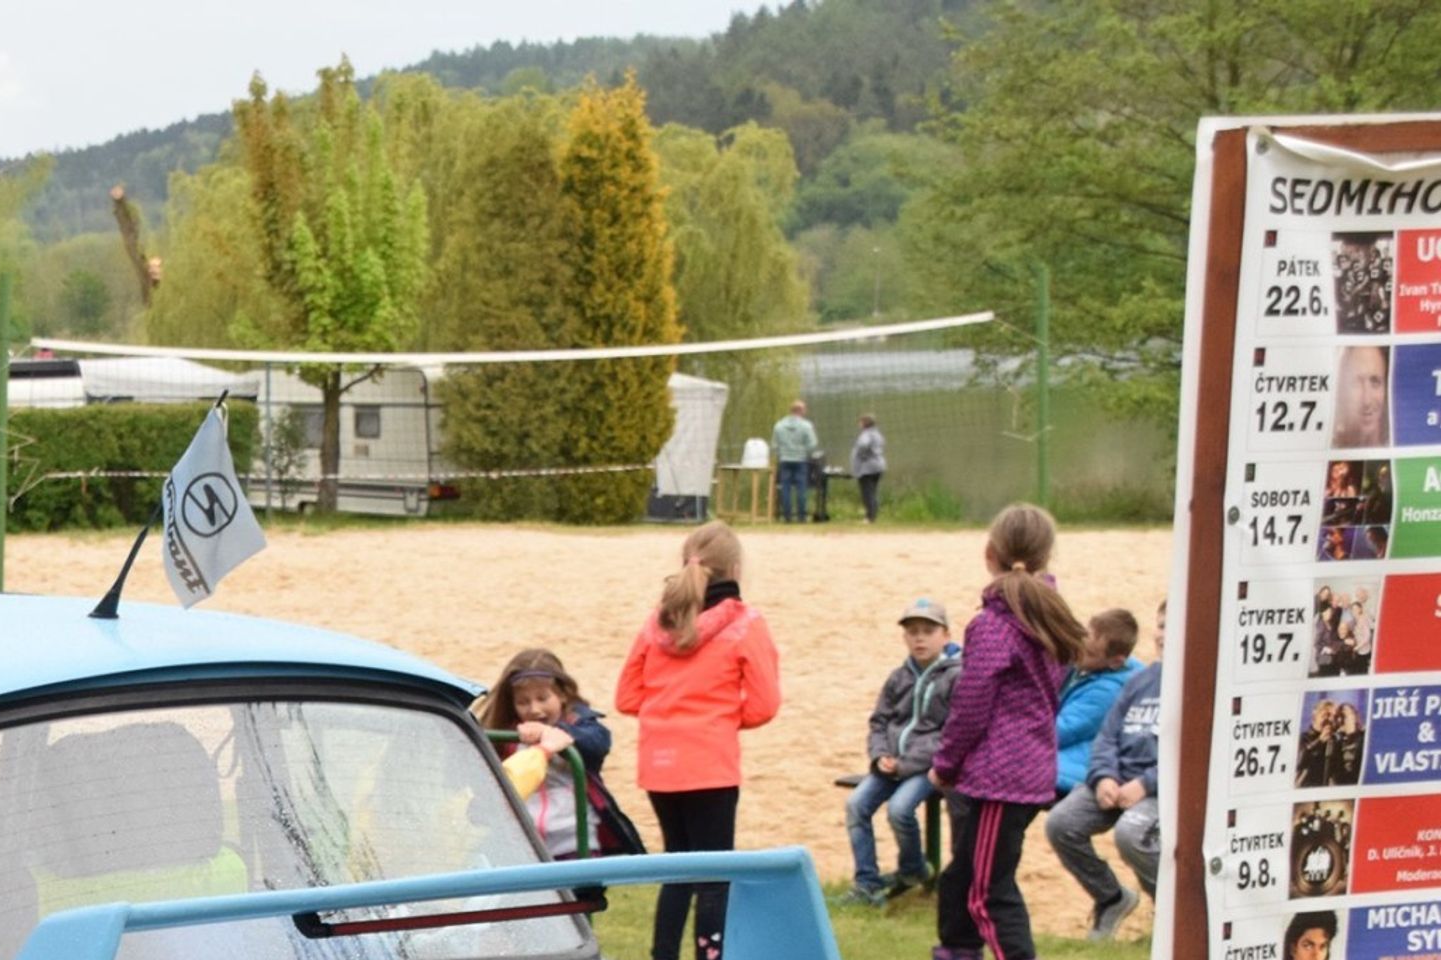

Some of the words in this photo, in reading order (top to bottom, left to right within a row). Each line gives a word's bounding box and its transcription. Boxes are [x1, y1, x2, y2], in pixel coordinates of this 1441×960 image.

[1277, 256, 1320, 277] PÁTEK
[1263, 285, 1328, 317] 22.6.
[1255, 373, 1329, 393] ČTVRTEK
[1256, 401, 1323, 432] 12.7.
[1251, 490, 1311, 507] SOBOTA
[1248, 515, 1309, 546] 14.7.
[1238, 606, 1306, 627] ČTVRTEK
[1240, 633, 1300, 664] 19.7.
[1373, 689, 1420, 719] JIŘÍ
[1425, 695, 1441, 716] P
[1233, 720, 1292, 741] ČTVRTEK
[1417, 721, 1437, 743] &
[1234, 745, 1287, 778] 26.7.
[1231, 832, 1285, 853] ČTVRTEK
[1237, 858, 1276, 890] 9.8.
